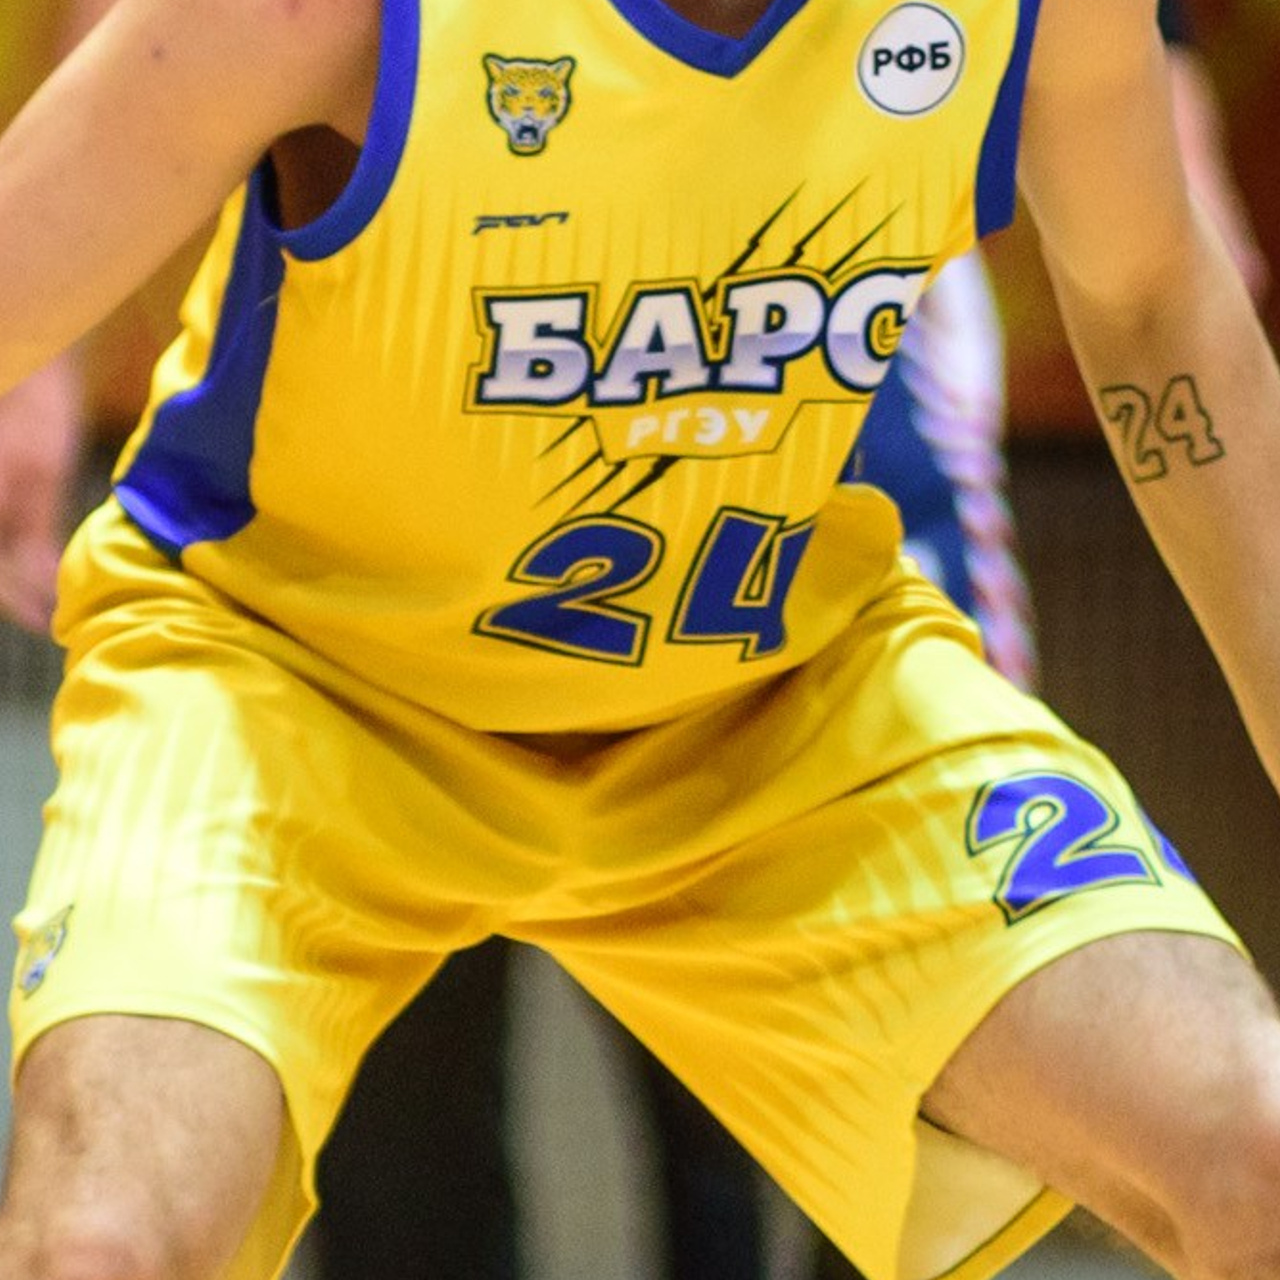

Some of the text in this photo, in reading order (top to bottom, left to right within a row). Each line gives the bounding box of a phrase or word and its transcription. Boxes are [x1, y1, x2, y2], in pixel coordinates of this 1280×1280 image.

[872, 41, 953, 77] РФБ
[476, 267, 932, 410] БАРС
[624, 406, 772, 451] РГЭУ
[1100, 374, 1227, 484] 24
[470, 506, 817, 668] 24
[965, 769, 1198, 928] 2
